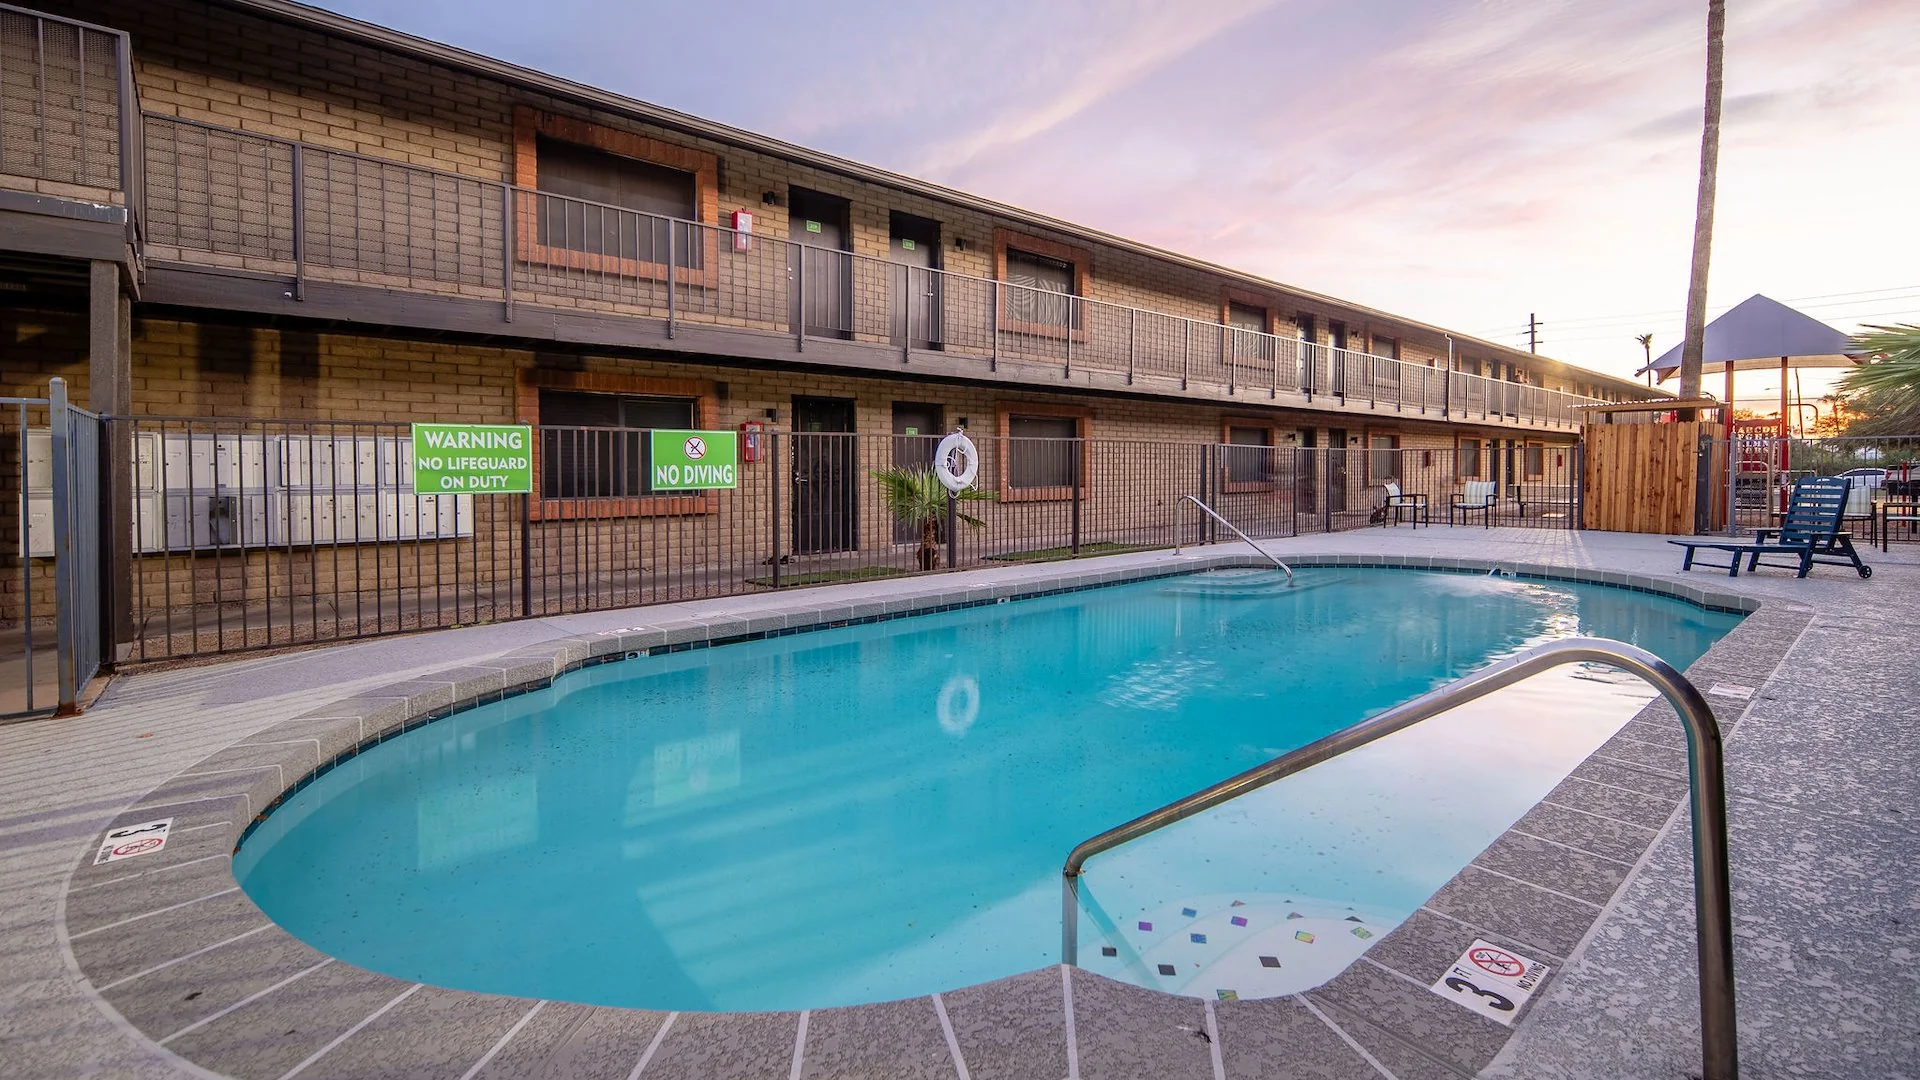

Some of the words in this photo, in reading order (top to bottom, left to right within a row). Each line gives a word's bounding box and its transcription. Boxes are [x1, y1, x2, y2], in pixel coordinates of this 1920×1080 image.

[424, 431, 523, 449] WARNING
[418, 456, 443, 470] NO
[447, 457, 527, 470] LIFEGUARD
[440, 475, 464, 489] ON
[469, 475, 509, 488] DUTY
[656, 464, 680, 485] NO
[684, 464, 733, 484] DIVING
[110, 823, 167, 838] 3
[1524, 962, 1546, 982] DIVING
[1516, 979, 1533, 991] NO
[1445, 977, 1515, 1011] 3
